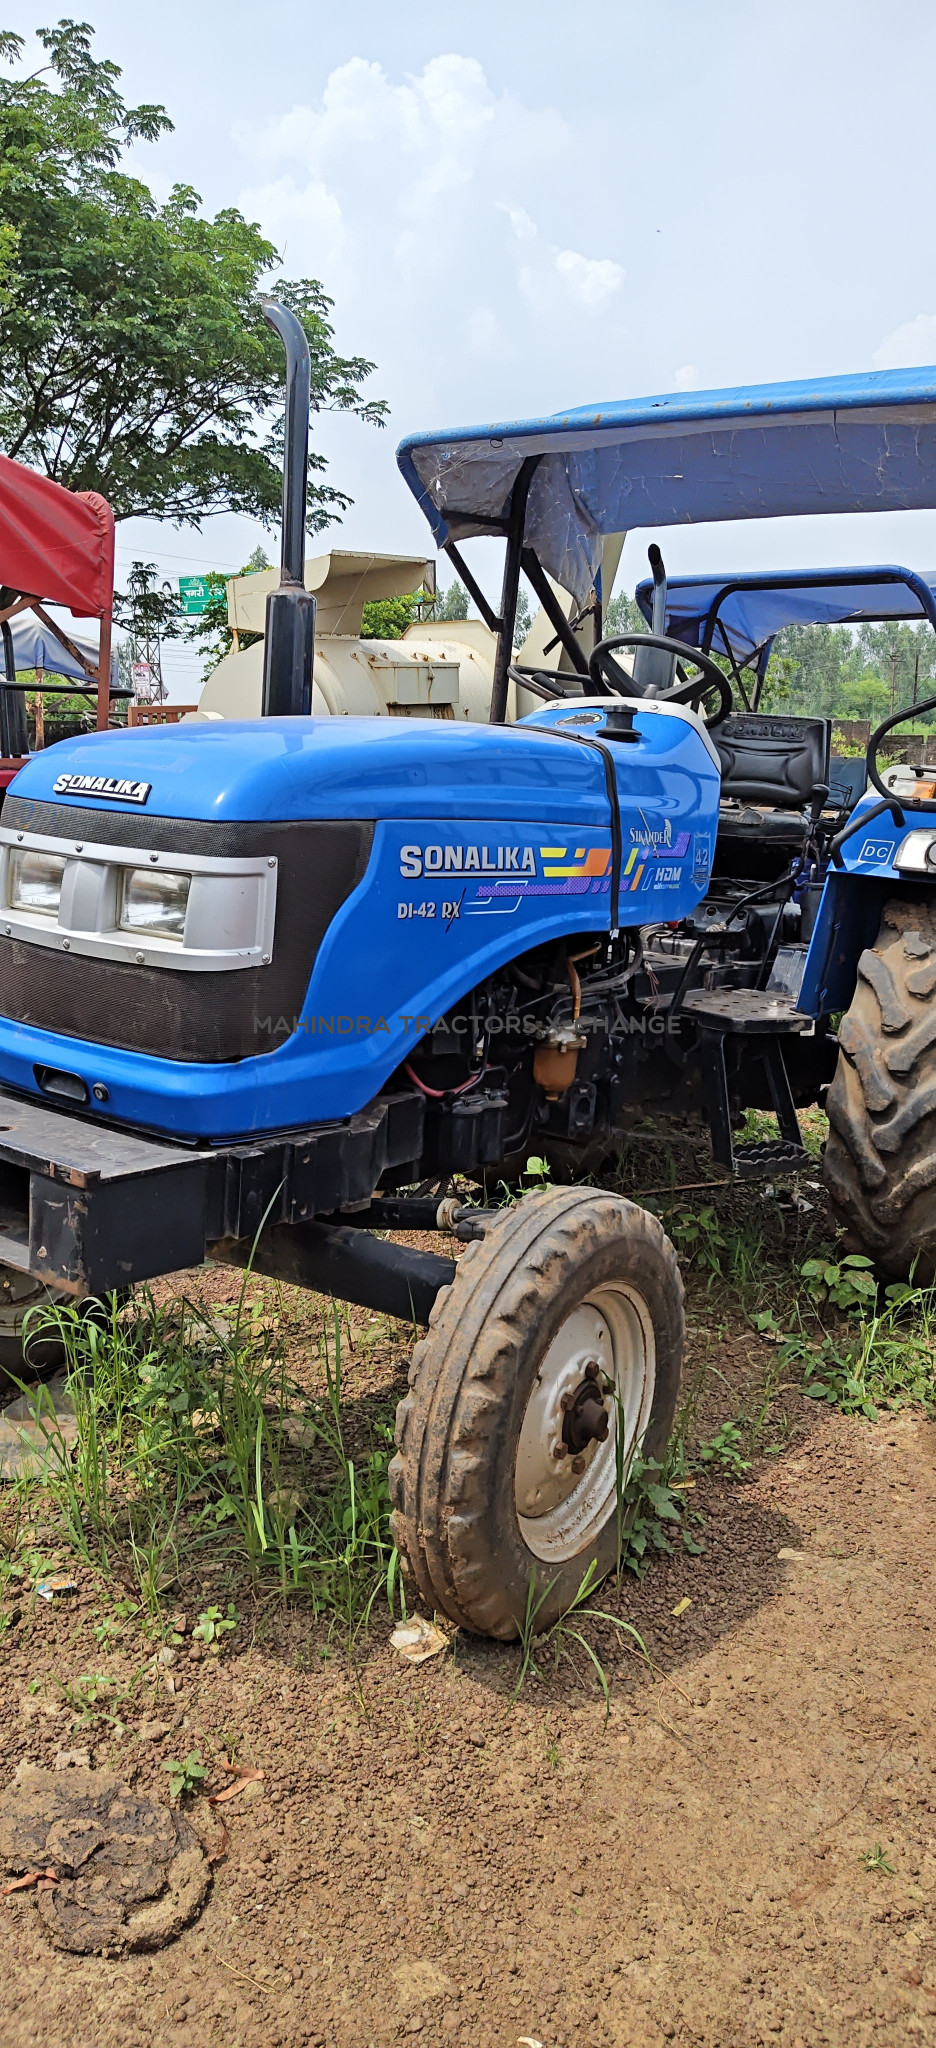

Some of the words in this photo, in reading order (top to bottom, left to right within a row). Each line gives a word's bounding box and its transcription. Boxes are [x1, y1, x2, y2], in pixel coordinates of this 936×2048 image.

[53, 774, 150, 803] SONALIKA
[695, 849, 708, 866] 42
[864, 846, 888, 858] DC
[400, 845, 536, 878] SONALIKA
[655, 867, 682, 882] HDM
[397, 902, 436, 919] DI-42
